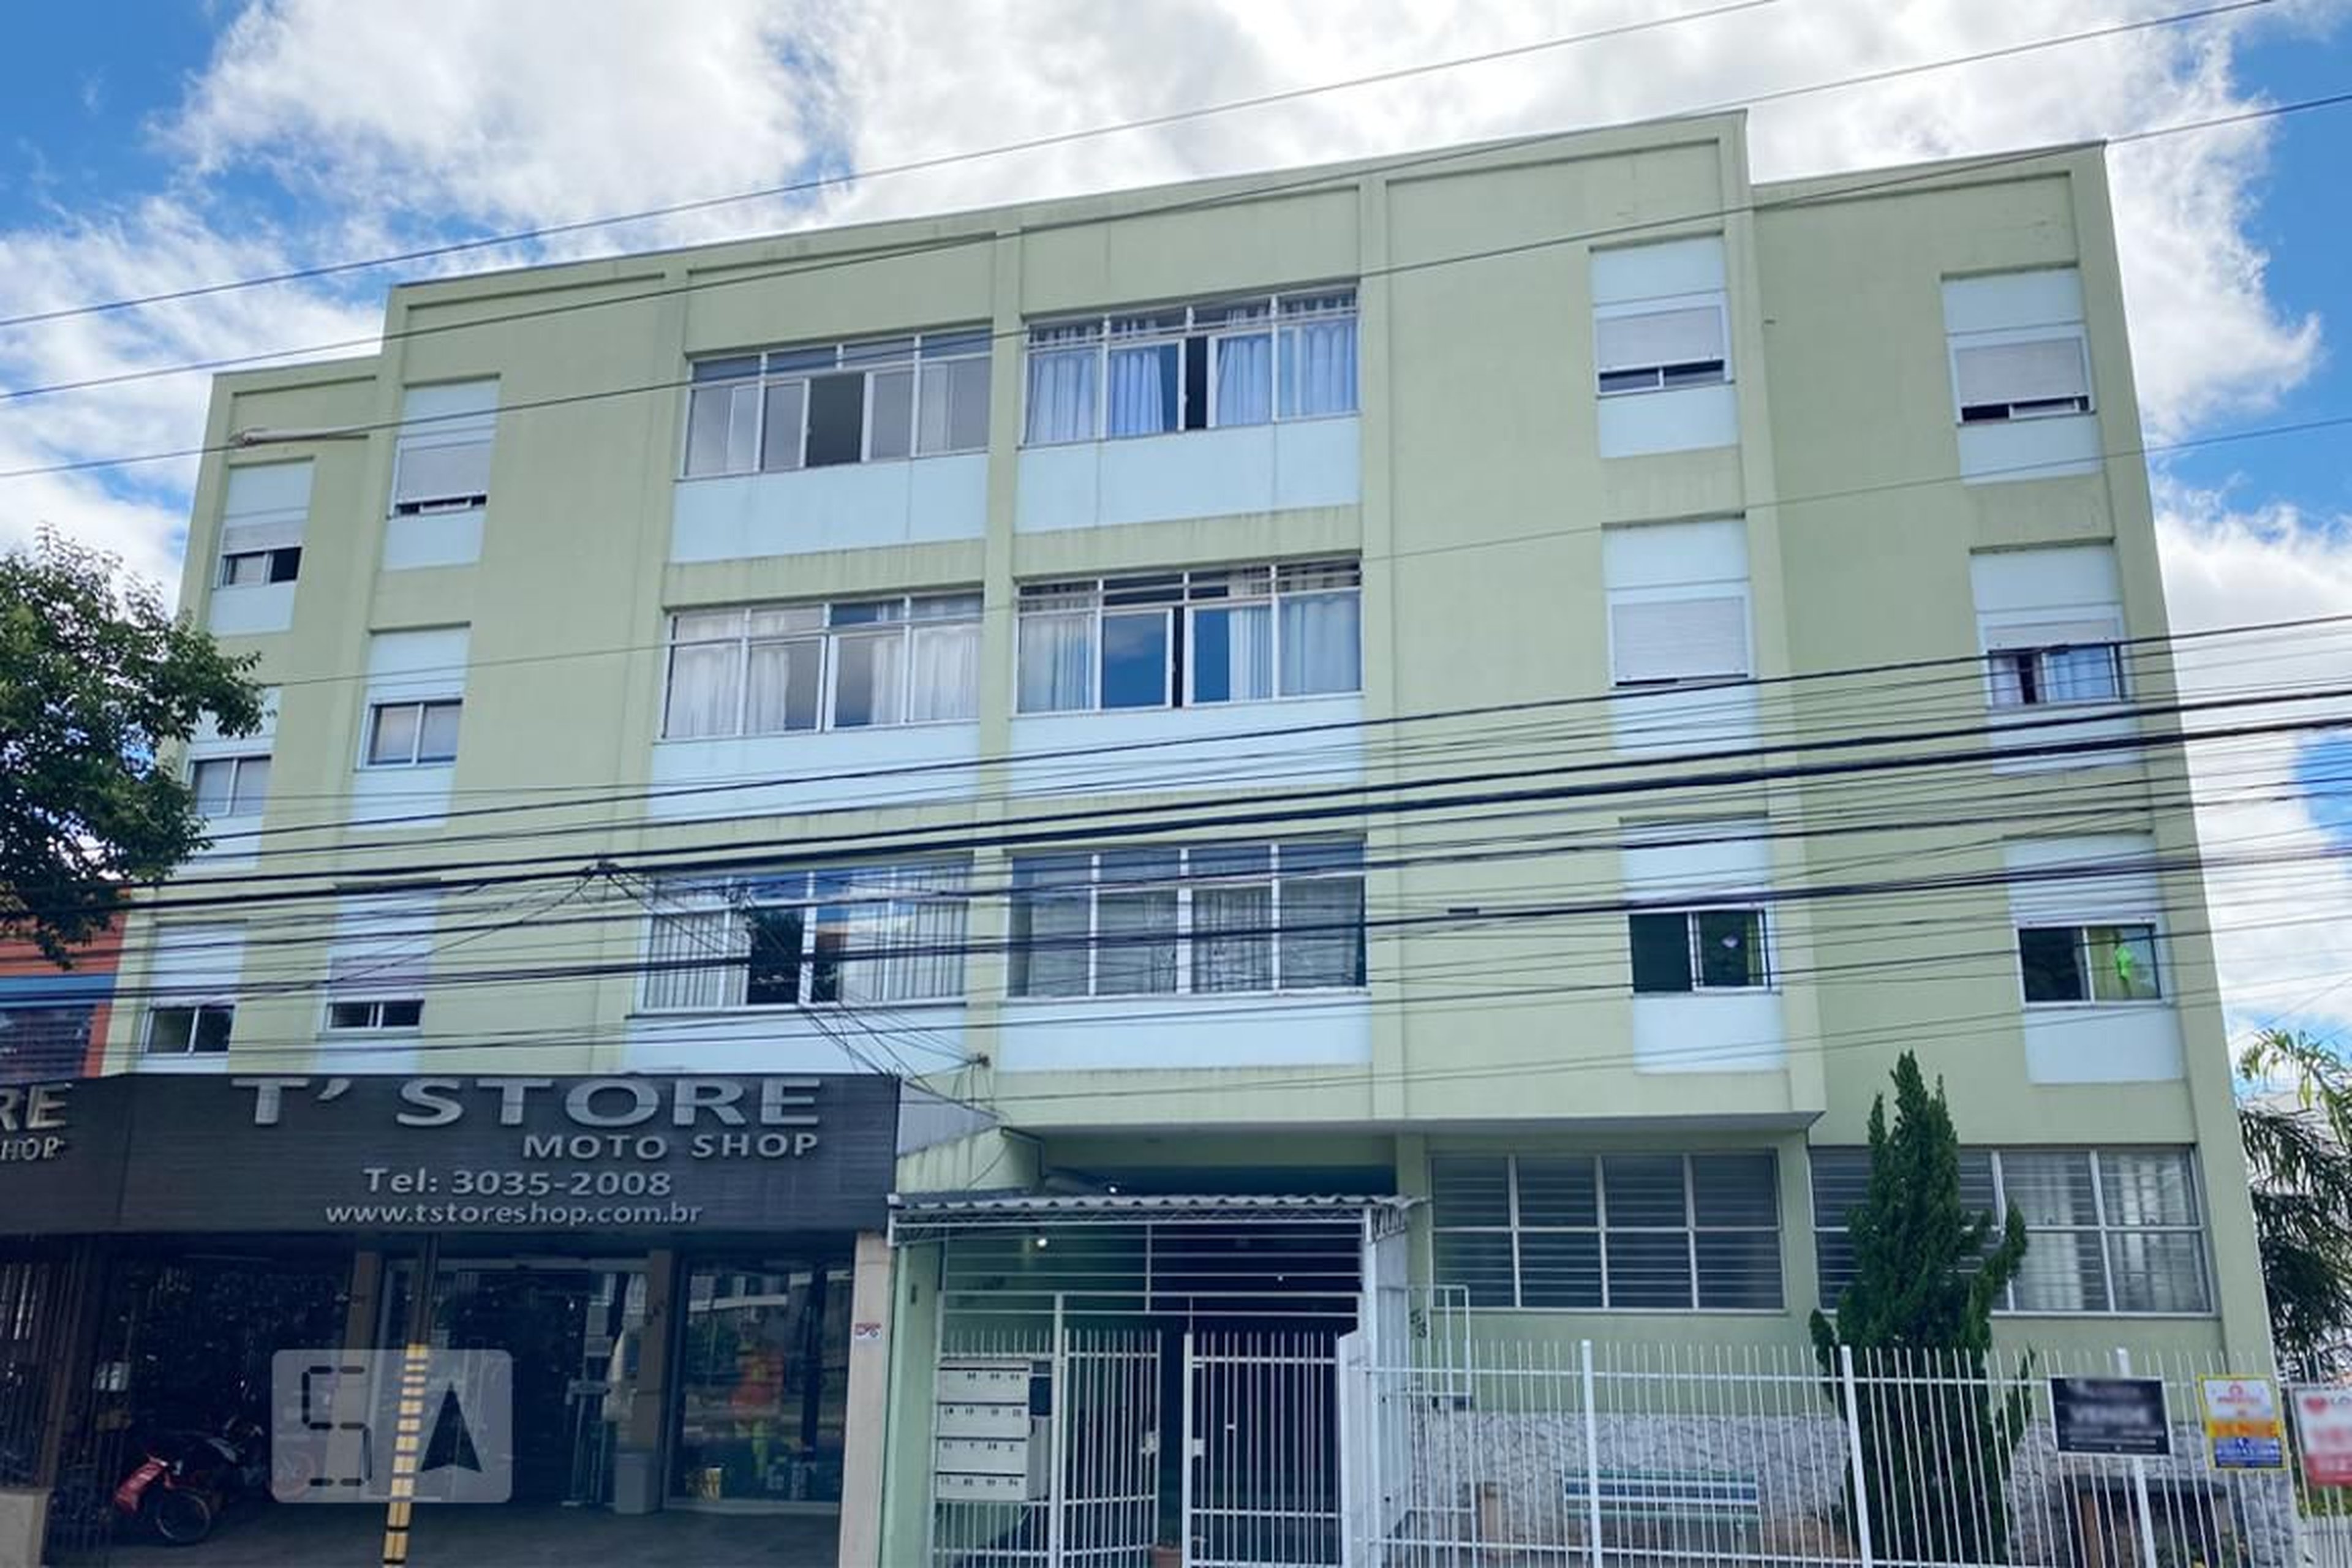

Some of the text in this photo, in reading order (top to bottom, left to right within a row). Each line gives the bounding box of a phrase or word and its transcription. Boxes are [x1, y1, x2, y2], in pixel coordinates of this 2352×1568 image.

[397, 1078, 821, 1126] STORE
[523, 1133, 818, 1159] MOTO SHOP
[364, 1167, 671, 1196] Tel: 3035-2008
[325, 1202, 703, 1226] www.tstoreshop.com.br
